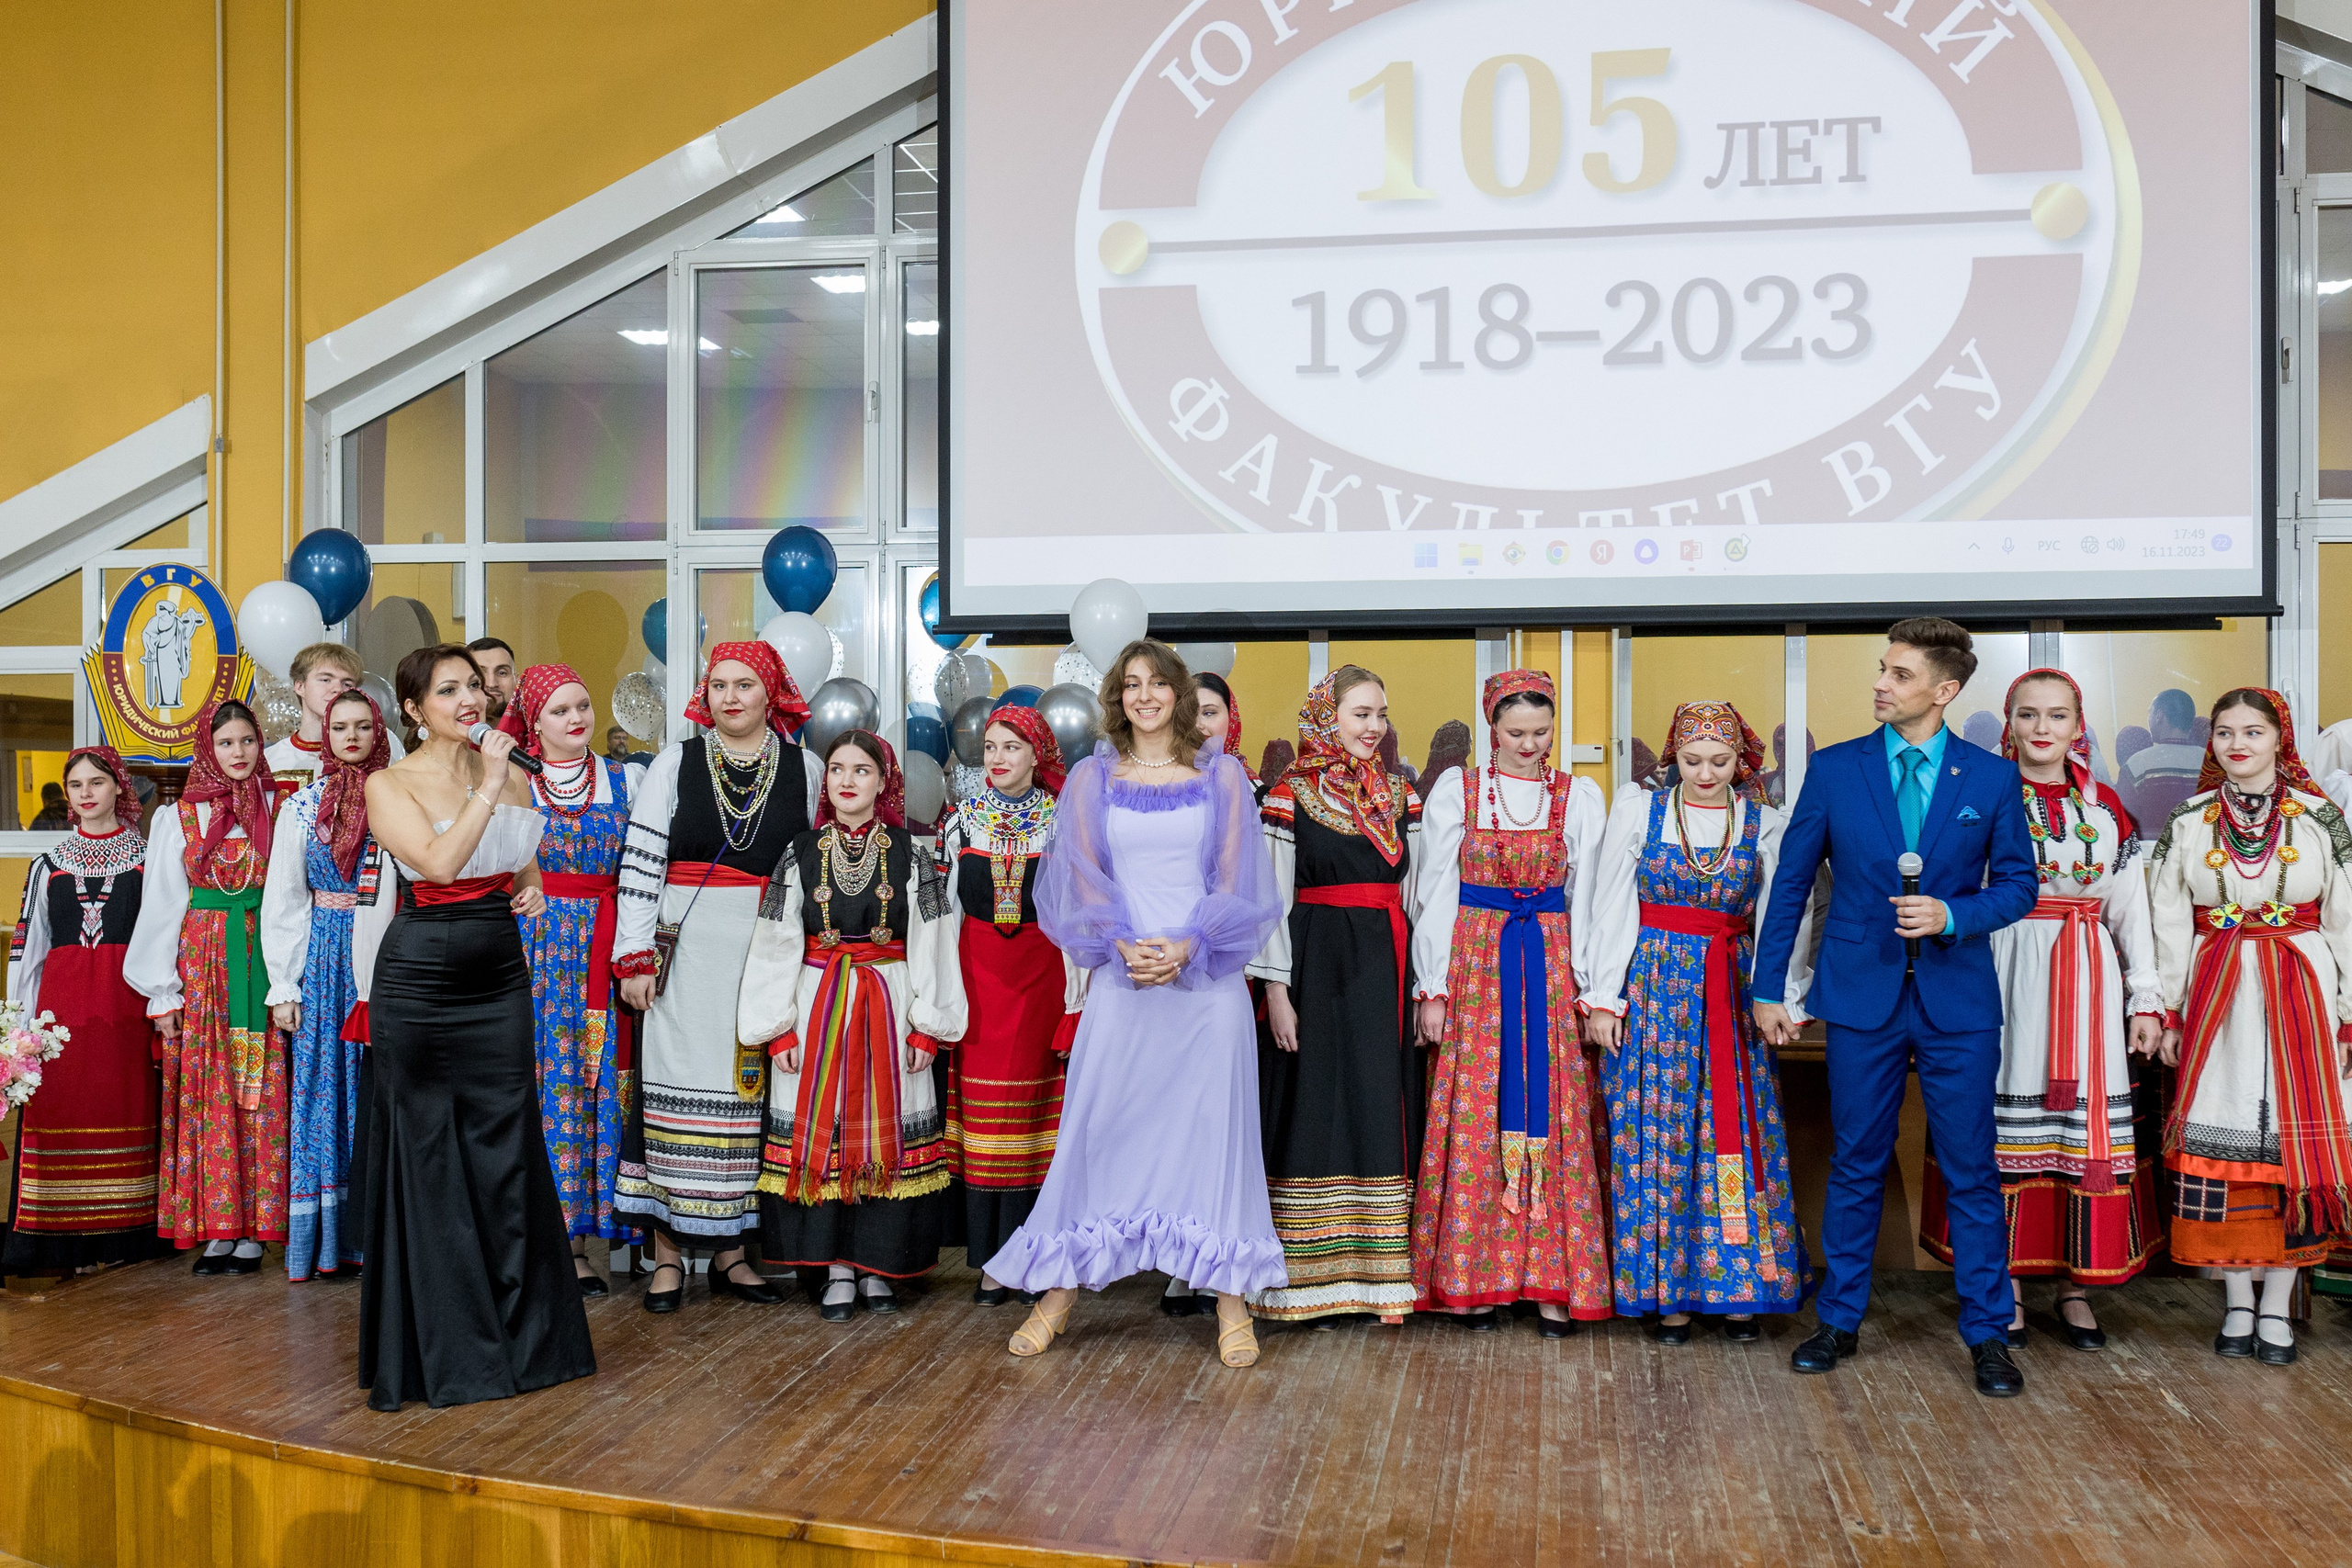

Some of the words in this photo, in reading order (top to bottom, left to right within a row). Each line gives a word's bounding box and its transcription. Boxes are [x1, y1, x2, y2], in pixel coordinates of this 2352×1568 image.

[1347, 47, 1679, 202] 105
[1703, 116, 1882, 189] ЛЕТ
[1169, 376, 1773, 533] ФАКУТ
[1820, 337, 2002, 517] ВГУ
[2174, 528, 2206, 540] 17:49
[2038, 540, 2061, 552] РУС
[2215, 537, 2228, 548] 22
[2142, 546, 2206, 558] 16.11.2023
[113, 682, 180, 739] ЮРИДИЧЕСКИЙ
[181, 685, 226, 735] ФАТЕТ
